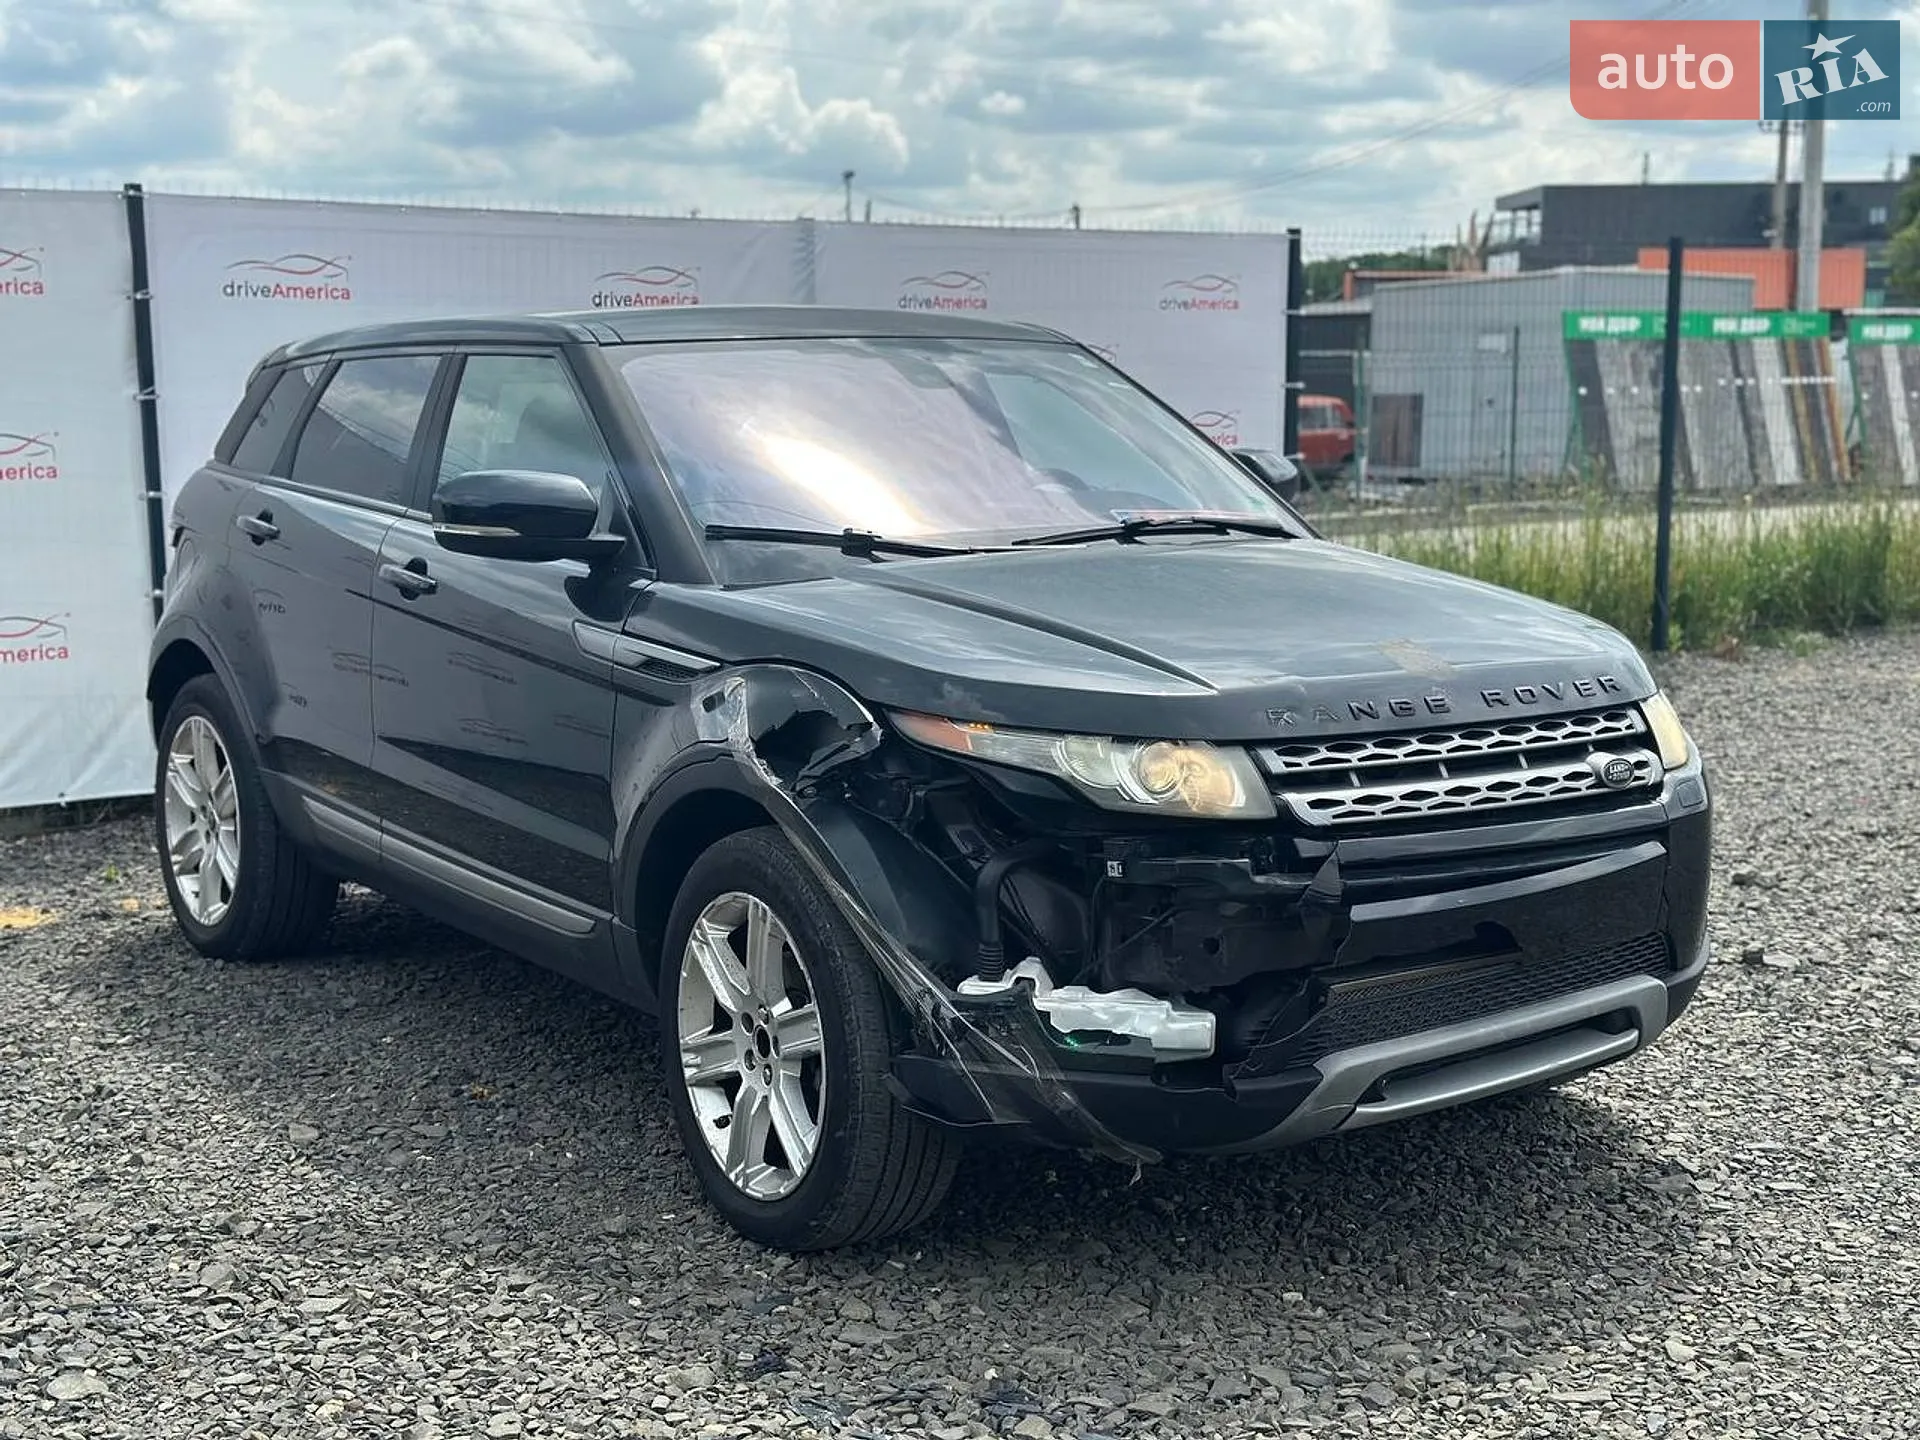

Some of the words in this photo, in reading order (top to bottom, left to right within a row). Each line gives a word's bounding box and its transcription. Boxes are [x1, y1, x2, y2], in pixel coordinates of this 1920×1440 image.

[0, 276, 45, 295] rica
[222, 280, 350, 300] driveAmerica
[591, 290, 699, 308] driveAmerica
[898, 293, 987, 310] driveAmerica
[0, 462, 58, 480] erica
[1265, 694, 1452, 727] RANGE
[1480, 675, 1621, 708] ROVER
